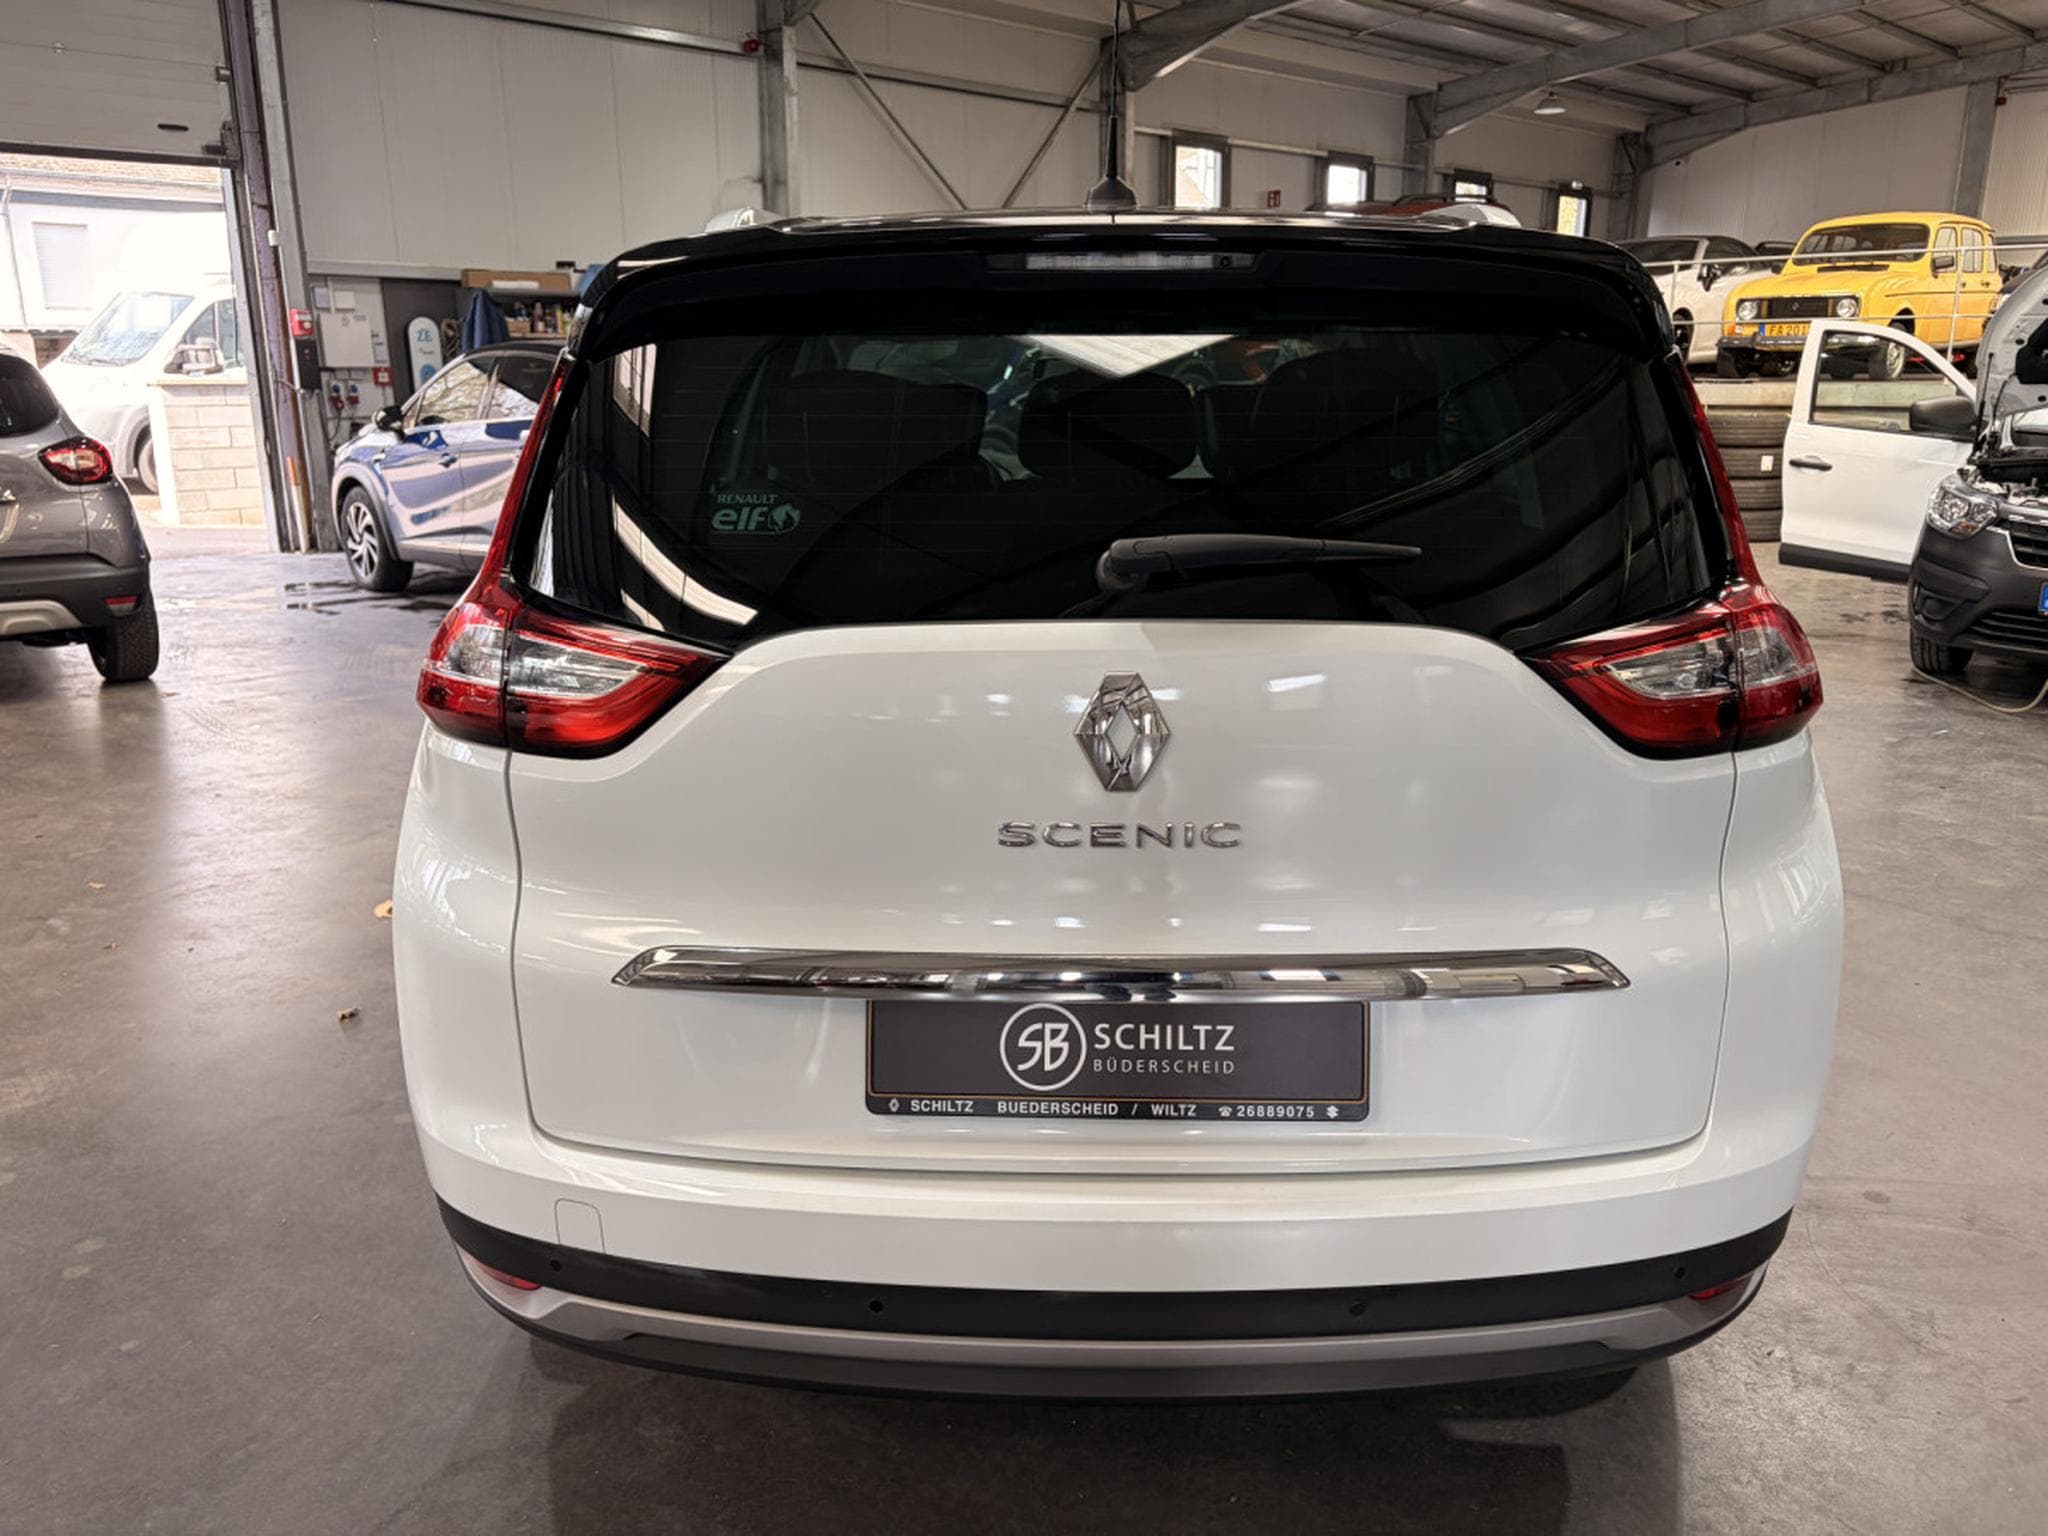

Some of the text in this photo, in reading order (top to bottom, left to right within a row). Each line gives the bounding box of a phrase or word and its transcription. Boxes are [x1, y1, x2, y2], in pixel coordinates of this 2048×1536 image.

[717, 494, 778, 504] RENAULT
[712, 506, 768, 530] elf
[998, 821, 1242, 848] SCENIC
[1017, 1022, 1070, 1072] SB
[1093, 1023, 1235, 1051] SCHILTZ
[1093, 1056, 1235, 1075] BÜDERSCHEID
[910, 1099, 974, 1113] SCHILTZ
[997, 1100, 1120, 1116] BUEDERSCHEID
[1151, 1103, 1197, 1117] WILTZ
[1236, 1105, 1315, 1118] 26889075
